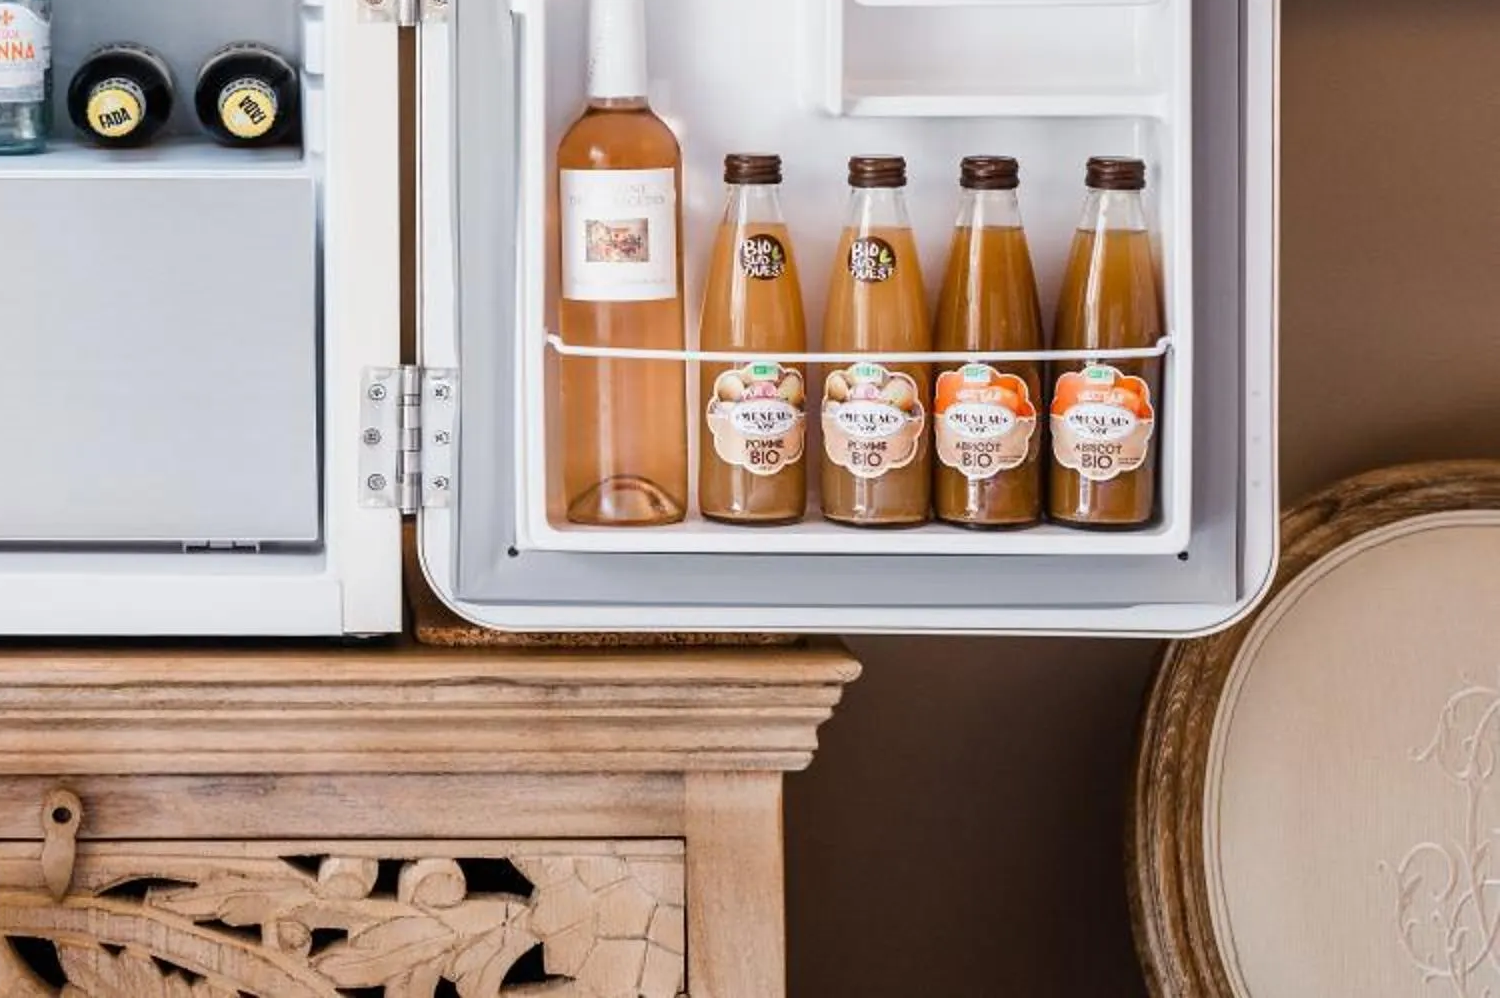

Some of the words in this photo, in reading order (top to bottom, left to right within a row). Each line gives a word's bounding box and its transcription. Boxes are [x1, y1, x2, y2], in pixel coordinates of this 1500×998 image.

[98, 107, 132, 129] FADA
[239, 95, 267, 125] FADA
[744, 439, 784, 449] POMME
[750, 449, 781, 465] BIO
[850, 451, 883, 467] BIO
[961, 451, 993, 468] BIO
[1080, 453, 1114, 469] BIO
